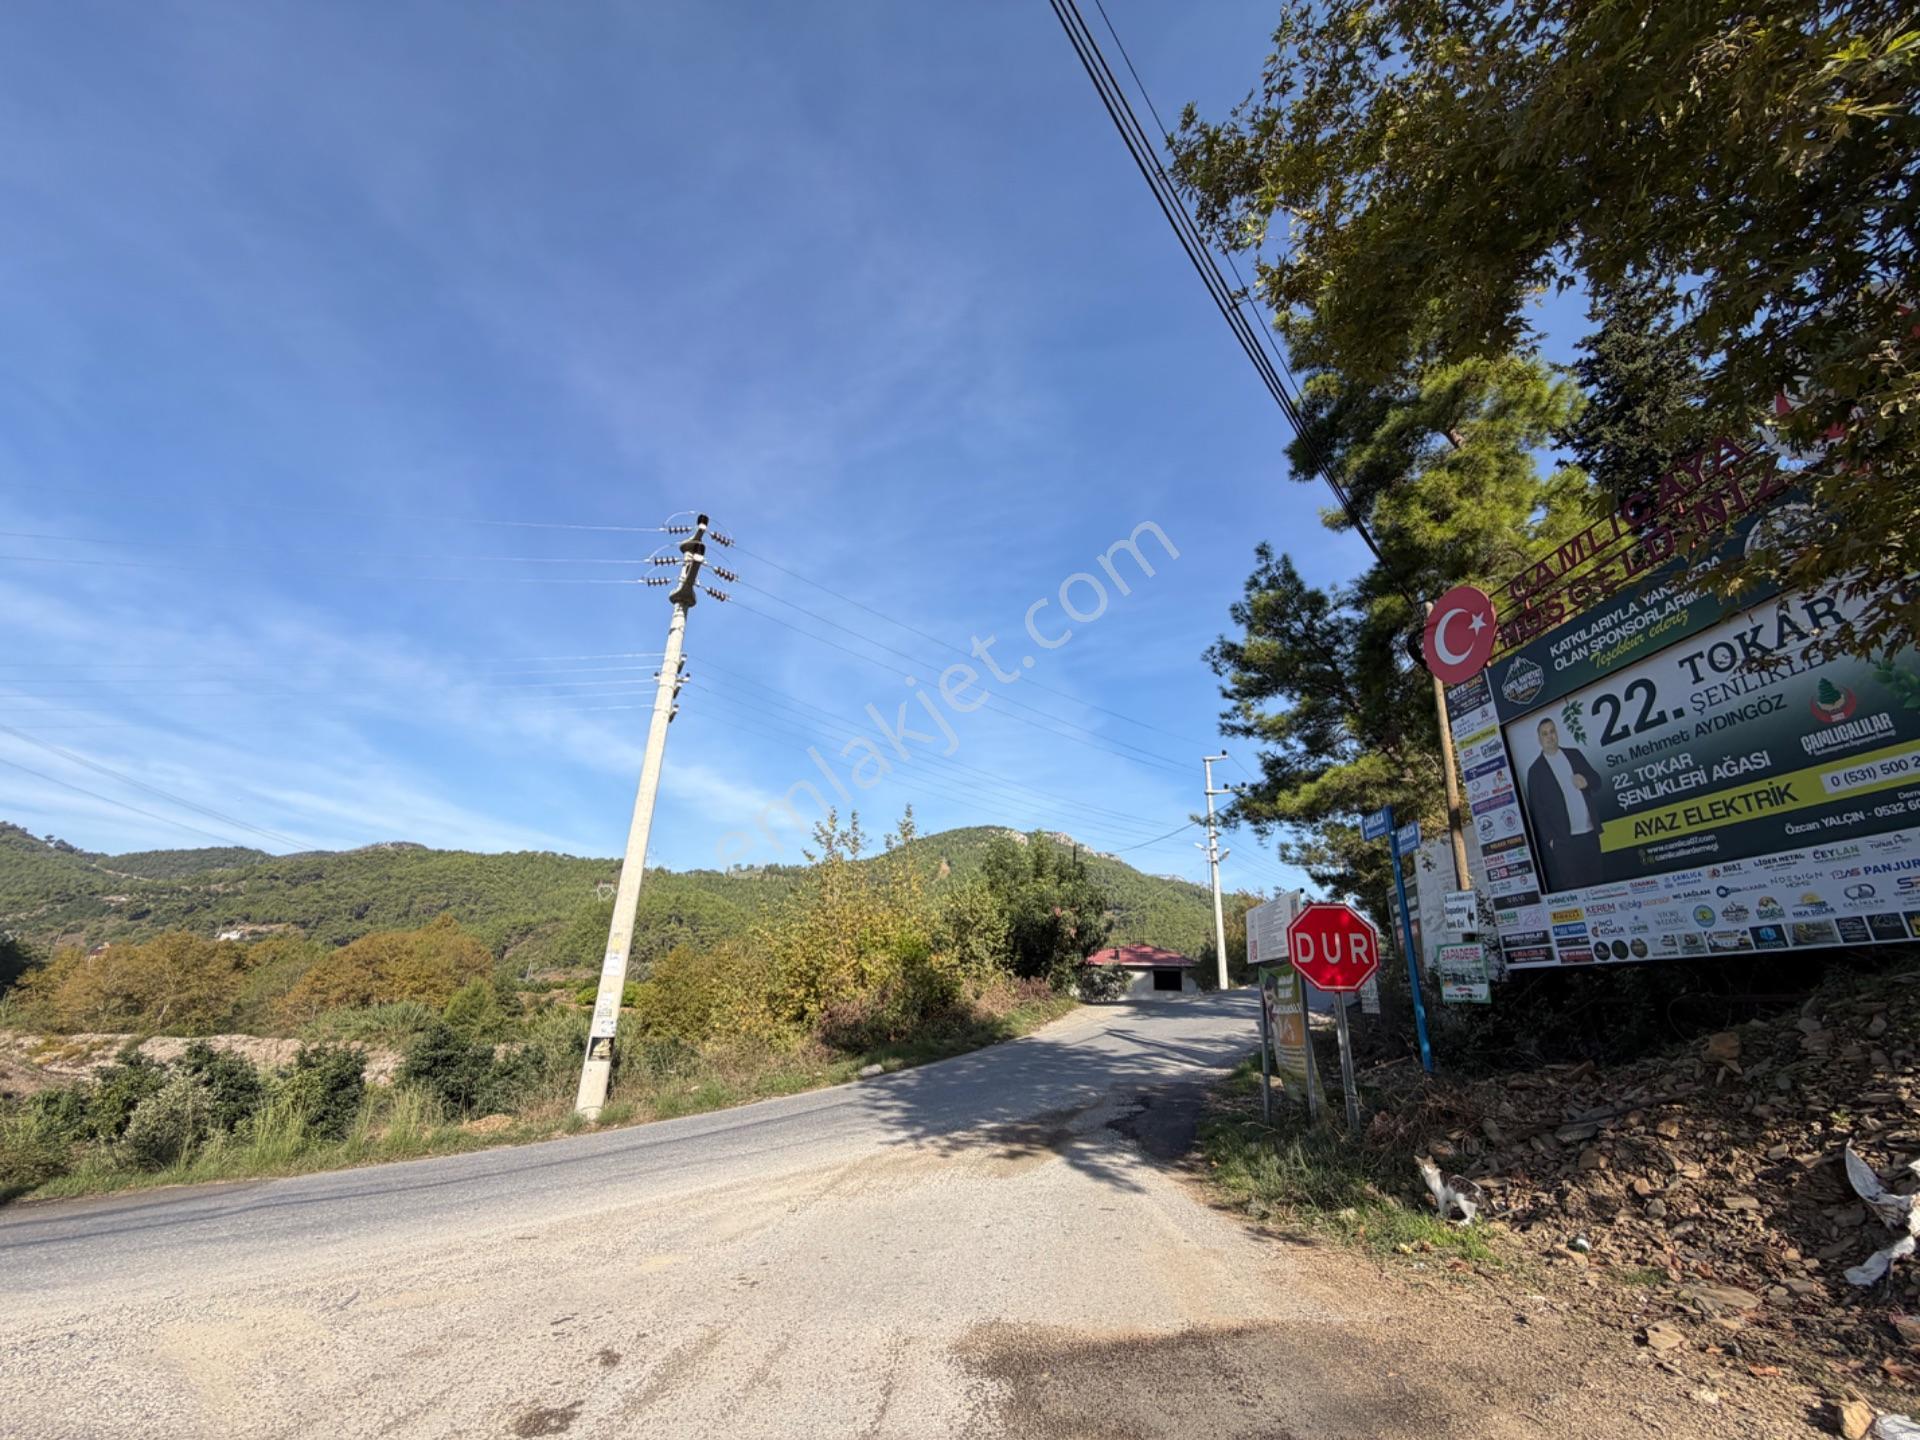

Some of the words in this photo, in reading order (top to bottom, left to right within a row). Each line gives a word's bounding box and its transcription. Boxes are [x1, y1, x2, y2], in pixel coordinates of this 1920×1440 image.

[1549, 602, 1640, 657] KATKILARIYLA
[1553, 645, 1589, 671] OLAN
[1591, 677, 1686, 747] 22.
[1677, 596, 1848, 685] TOKAR
[1606, 754, 1627, 768] Sn.
[1629, 729, 1690, 762] Mehmet
[1695, 693, 1788, 738] AYDINGÖZ
[1612, 773, 1634, 790] 22.
[1634, 752, 1695, 783] TOKAR
[1617, 766, 1709, 811] ŞENLİKLERİ
[1712, 749, 1772, 782] AĞASI
[1830, 775, 1841, 788] 0
[1844, 766, 1877, 786] (531)
[1880, 759, 1909, 776] 500
[1634, 812, 1681, 840] AYAZ
[1683, 781, 1799, 827] ELEKTRİK
[1784, 821, 1820, 835] Özcan
[1821, 810, 1866, 828] YALÇIN
[1873, 802, 1907, 818] 0532
[1295, 932, 1370, 965] DUR
